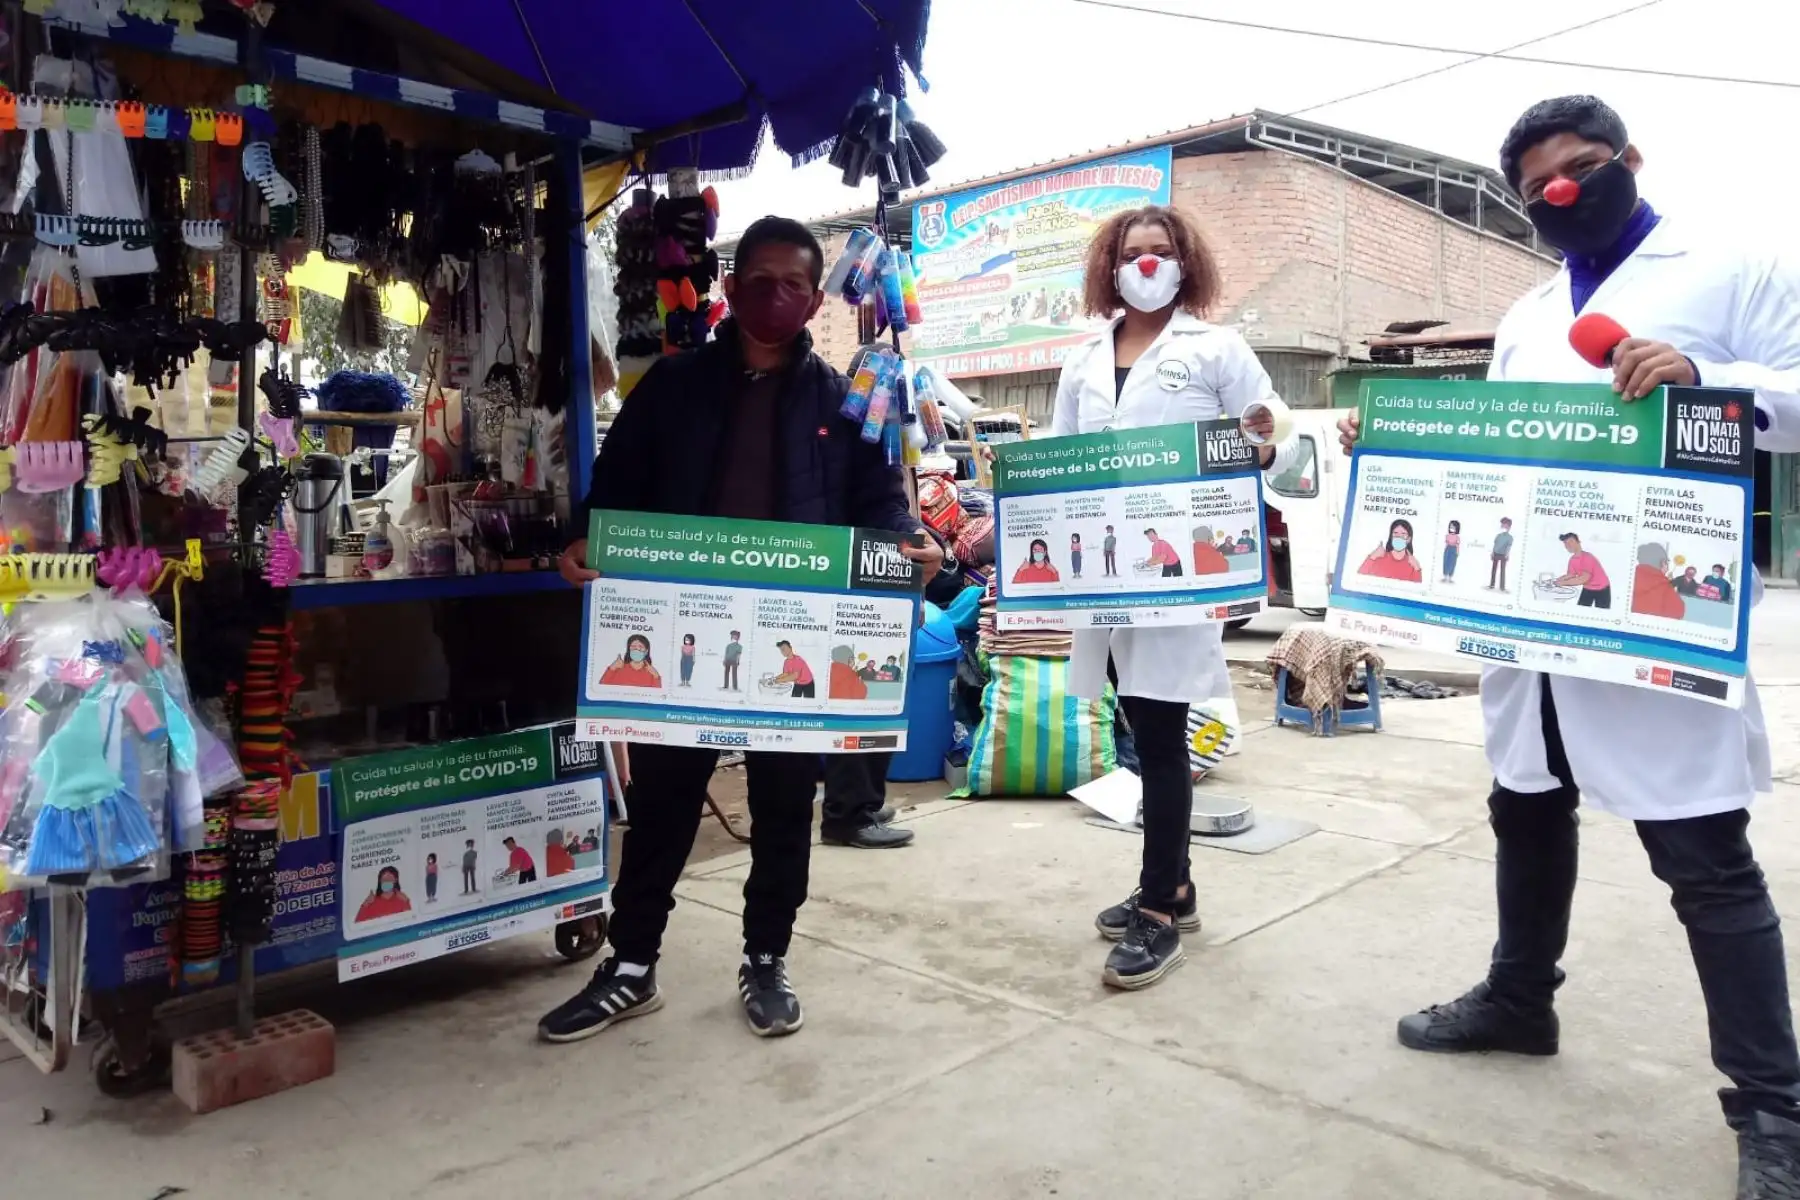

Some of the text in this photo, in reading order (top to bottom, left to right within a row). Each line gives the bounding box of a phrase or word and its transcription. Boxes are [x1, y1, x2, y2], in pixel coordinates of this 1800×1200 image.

[1045, 170, 1098, 193] NOMBRE
[1100, 167, 1118, 184] DE
[1375, 396, 1620, 417] Cuida tu salud y la de tu familia.
[1678, 404, 1722, 420] EL COVID
[1206, 428, 1239, 440] EL COVID
[1373, 418, 1639, 445] Protégete de la COVID-19
[1677, 419, 1740, 453] NO MATA
[1005, 452, 1033, 463] Cuida
[1036, 452, 1046, 460] tu
[1048, 448, 1075, 459] salud
[1078, 449, 1083, 457] y
[1086, 446, 1094, 454] la
[1097, 444, 1110, 453] de
[1113, 443, 1124, 451] tu
[1206, 439, 1231, 462] NO
[1710, 438, 1740, 455] SOLO
[1231, 447, 1253, 460] SOLO
[1007, 450, 1180, 480] Protégete de la COVID-19
[1367, 465, 1382, 474] USA
[1366, 474, 1434, 488] CORRECTAMENTE
[1446, 481, 1457, 490] DE
[1465, 483, 1498, 493] METRO
[1578, 479, 1598, 490] LAS
[1365, 485, 1425, 497] LA MASCARILLA
[1444, 491, 1504, 504] DE DISTANCIA
[1536, 488, 1604, 501] MANOS CON
[1646, 486, 1695, 499] EVITA LAS
[1365, 494, 1411, 506] CUBRIENDO
[1535, 497, 1565, 508] AGUA
[1568, 499, 1574, 508] Y
[1645, 498, 1704, 512] REUNIONES
[1364, 505, 1418, 517] NARIZ Y BOCA
[1534, 507, 1633, 524] FRECUENTEMENTE
[1643, 509, 1732, 529] FAMILIARES Y LAS
[608, 525, 646, 537] Cuida
[650, 528, 664, 539] tu
[667, 530, 703, 541] salud
[706, 533, 714, 544] y
[717, 532, 728, 543] la
[731, 533, 748, 544] de
[752, 535, 765, 545] tu
[1642, 521, 1738, 541] AGLOMERACIONES
[862, 540, 898, 553] EL COVID
[606, 545, 830, 572] Protégete de la COVID-19
[860, 550, 887, 577] NO
[887, 564, 912, 578] SOLO
[837, 602, 859, 610] EVITA
[600, 613, 646, 623] CUBRIENDO
[691, 611, 733, 620] DISTANCIA
[836, 611, 881, 621] REUNIONES
[600, 622, 623, 630] NARIZ
[631, 624, 654, 633] BOCA
[757, 621, 828, 632] FRECUENTEMENTE
[835, 620, 881, 630] FAMILIARES
[888, 622, 903, 630] LAS
[1424, 612, 1440, 622] Para
[1501, 625, 1525, 637] llama
[1526, 630, 1550, 643] gratis
[1552, 632, 1561, 641] al
[1573, 635, 1590, 645] 113
[1591, 637, 1623, 650] SALUD
[834, 629, 907, 639] AGLOMERACIONES
[1459, 641, 1516, 660] DE TODOS
[559, 736, 567, 745] EL
[700, 734, 748, 744] DE TODOS
[560, 743, 580, 767] NO
[580, 750, 597, 763] SOLO
[352, 768, 387, 782] Cuida
[390, 766, 401, 775] tu
[404, 759, 434, 772] salud
[437, 760, 443, 768] y
[446, 756, 456, 765] la
[458, 752, 472, 763] de
[475, 752, 486, 761] tu
[355, 757, 538, 802] Protégete de la COVID-19
[299, 866, 315, 879] de
[287, 895, 312, 913] DE
